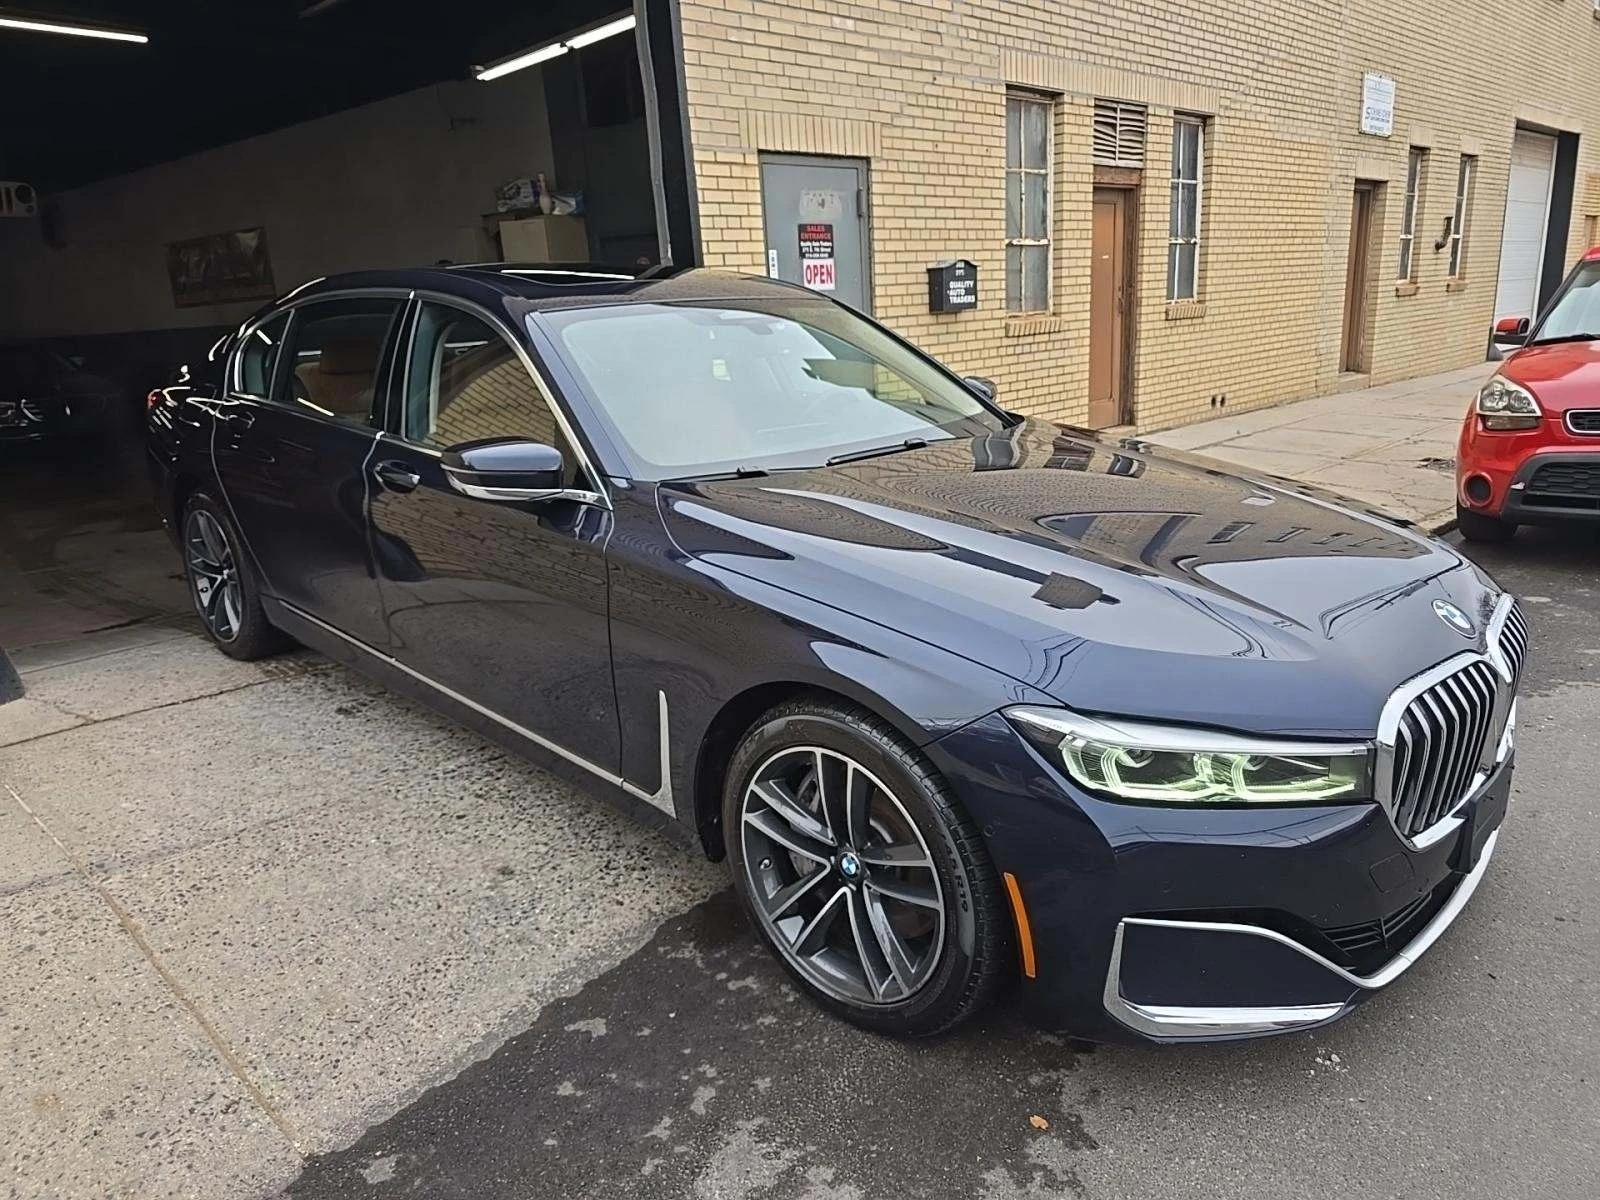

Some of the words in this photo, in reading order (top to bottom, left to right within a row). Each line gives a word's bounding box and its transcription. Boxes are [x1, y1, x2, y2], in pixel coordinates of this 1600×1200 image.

[801, 232, 831, 240] ENTRANCE
[805, 264, 833, 285] OPEN
[949, 281, 974, 289] QUALITY
[949, 288, 966, 296] AUTO
[949, 295, 975, 303] TRADERS
